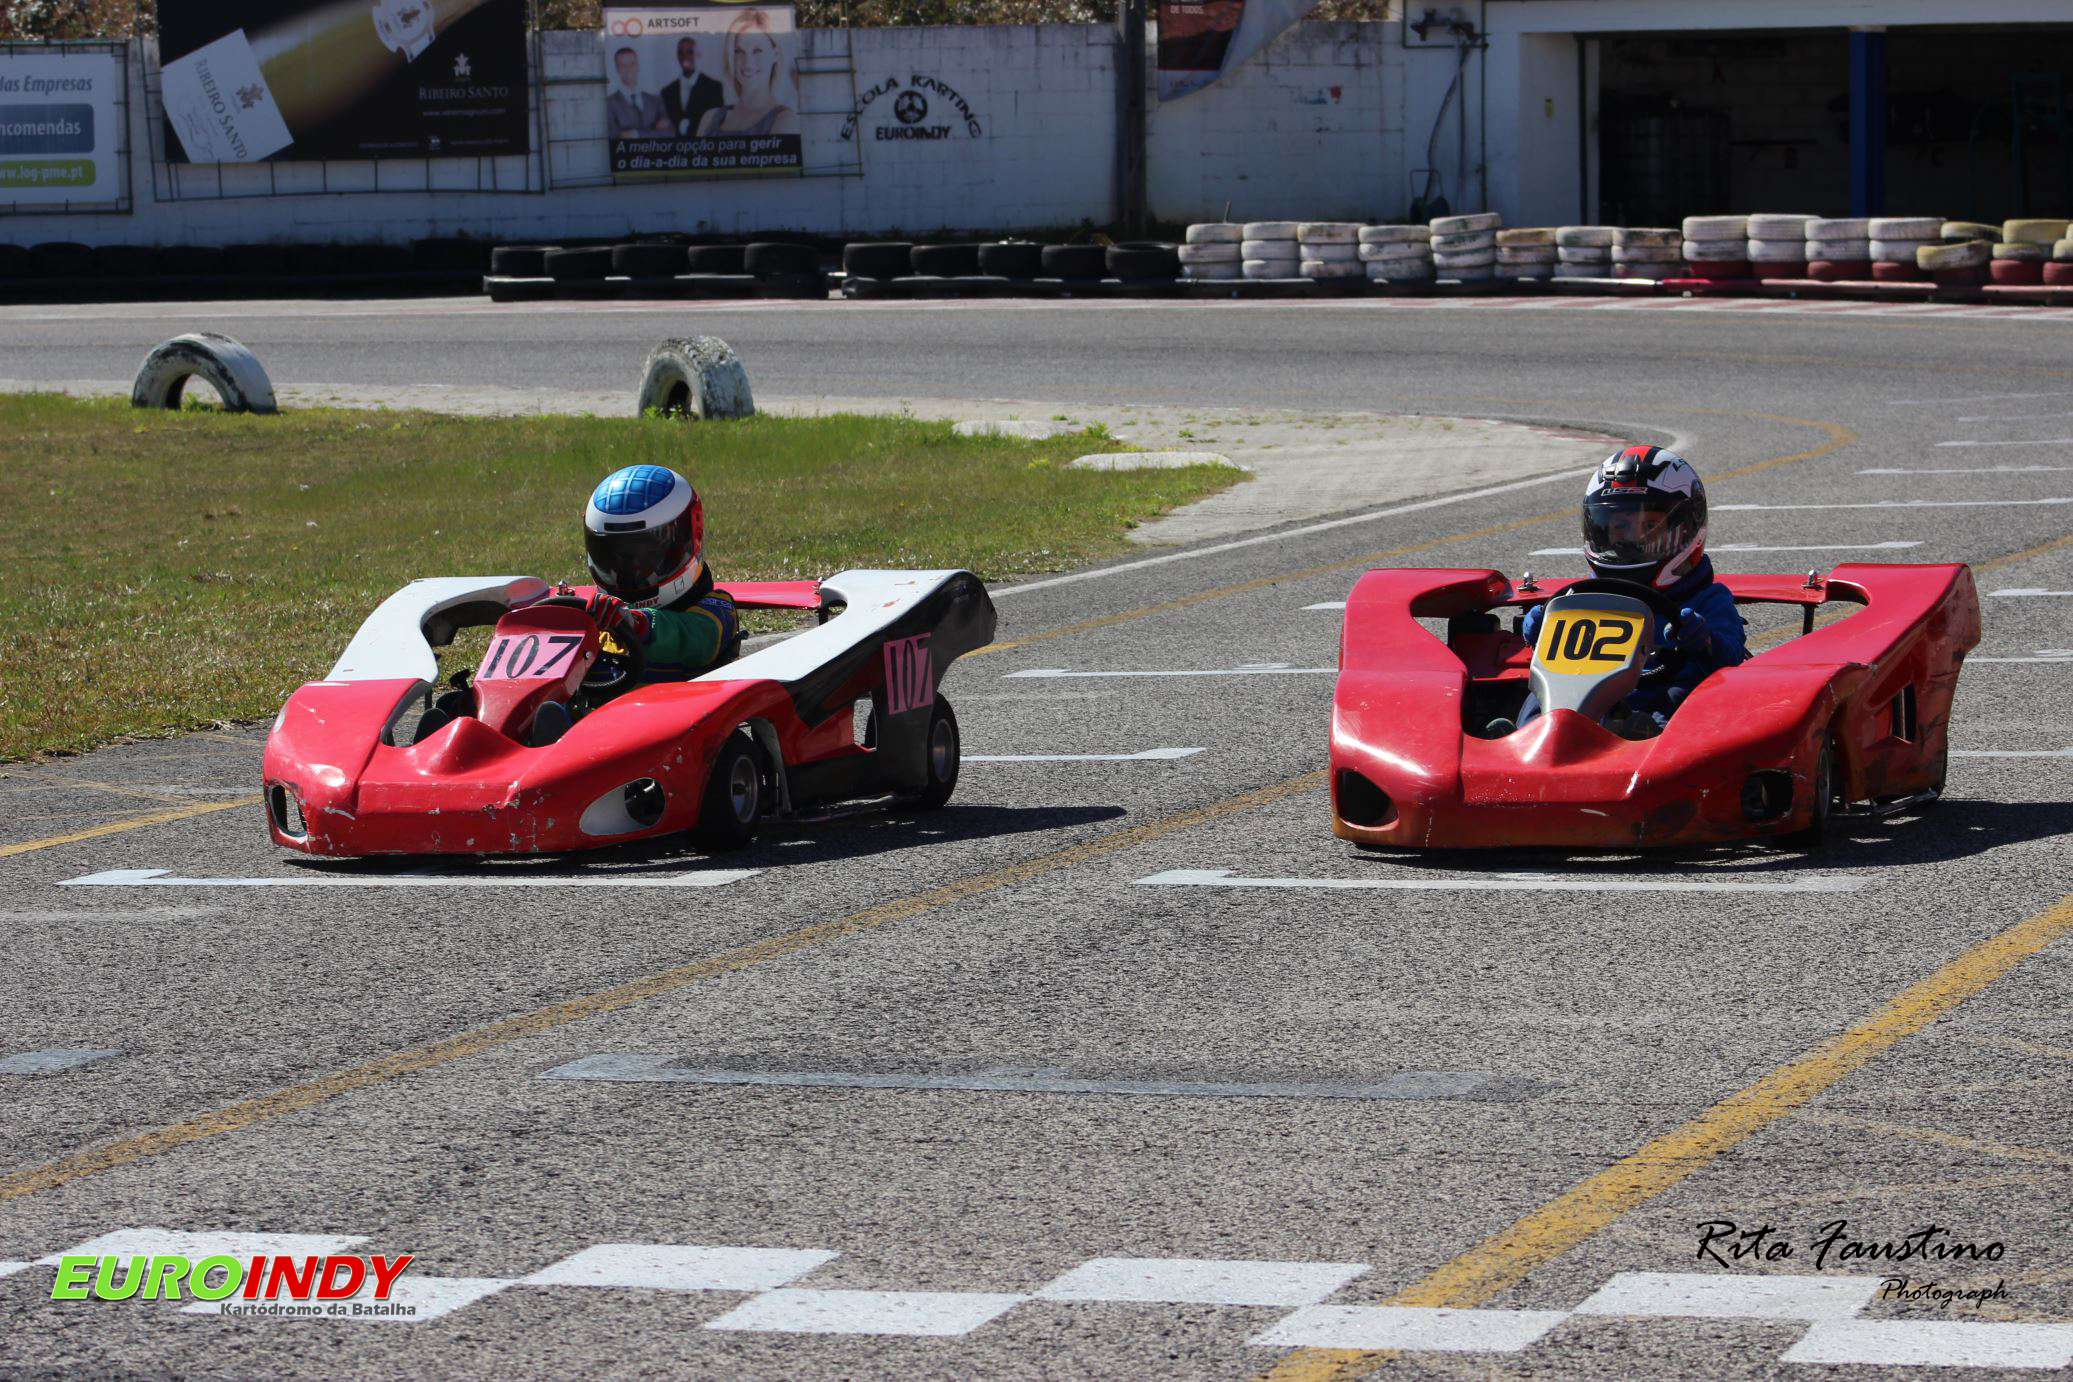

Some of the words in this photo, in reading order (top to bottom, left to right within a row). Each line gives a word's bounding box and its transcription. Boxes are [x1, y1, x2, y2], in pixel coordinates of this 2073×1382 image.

[647, 17, 700, 29] ARTSOFT
[24, 75, 93, 96] Empresas
[419, 87, 466, 100] RIBEIRO
[468, 86, 509, 98] SANTO
[194, 59, 226, 114] RIBEIRO
[219, 114, 248, 159] SANTO
[911, 75, 982, 139] KARTING
[875, 126, 951, 140] EUROINDY
[616, 141, 626, 153] A
[629, 140, 673, 152] melhor
[676, 140, 714, 155] opção
[718, 140, 746, 153] para
[750, 137, 782, 151] gerir
[617, 159, 626, 169] o
[630, 155, 688, 169] dia-a-dia
[692, 154, 709, 167] da
[712, 155, 736, 166] sua
[740, 153, 797, 168] empresa
[1546, 619, 1633, 661] 102
[483, 635, 582, 679] 107
[887, 637, 932, 711] 107
